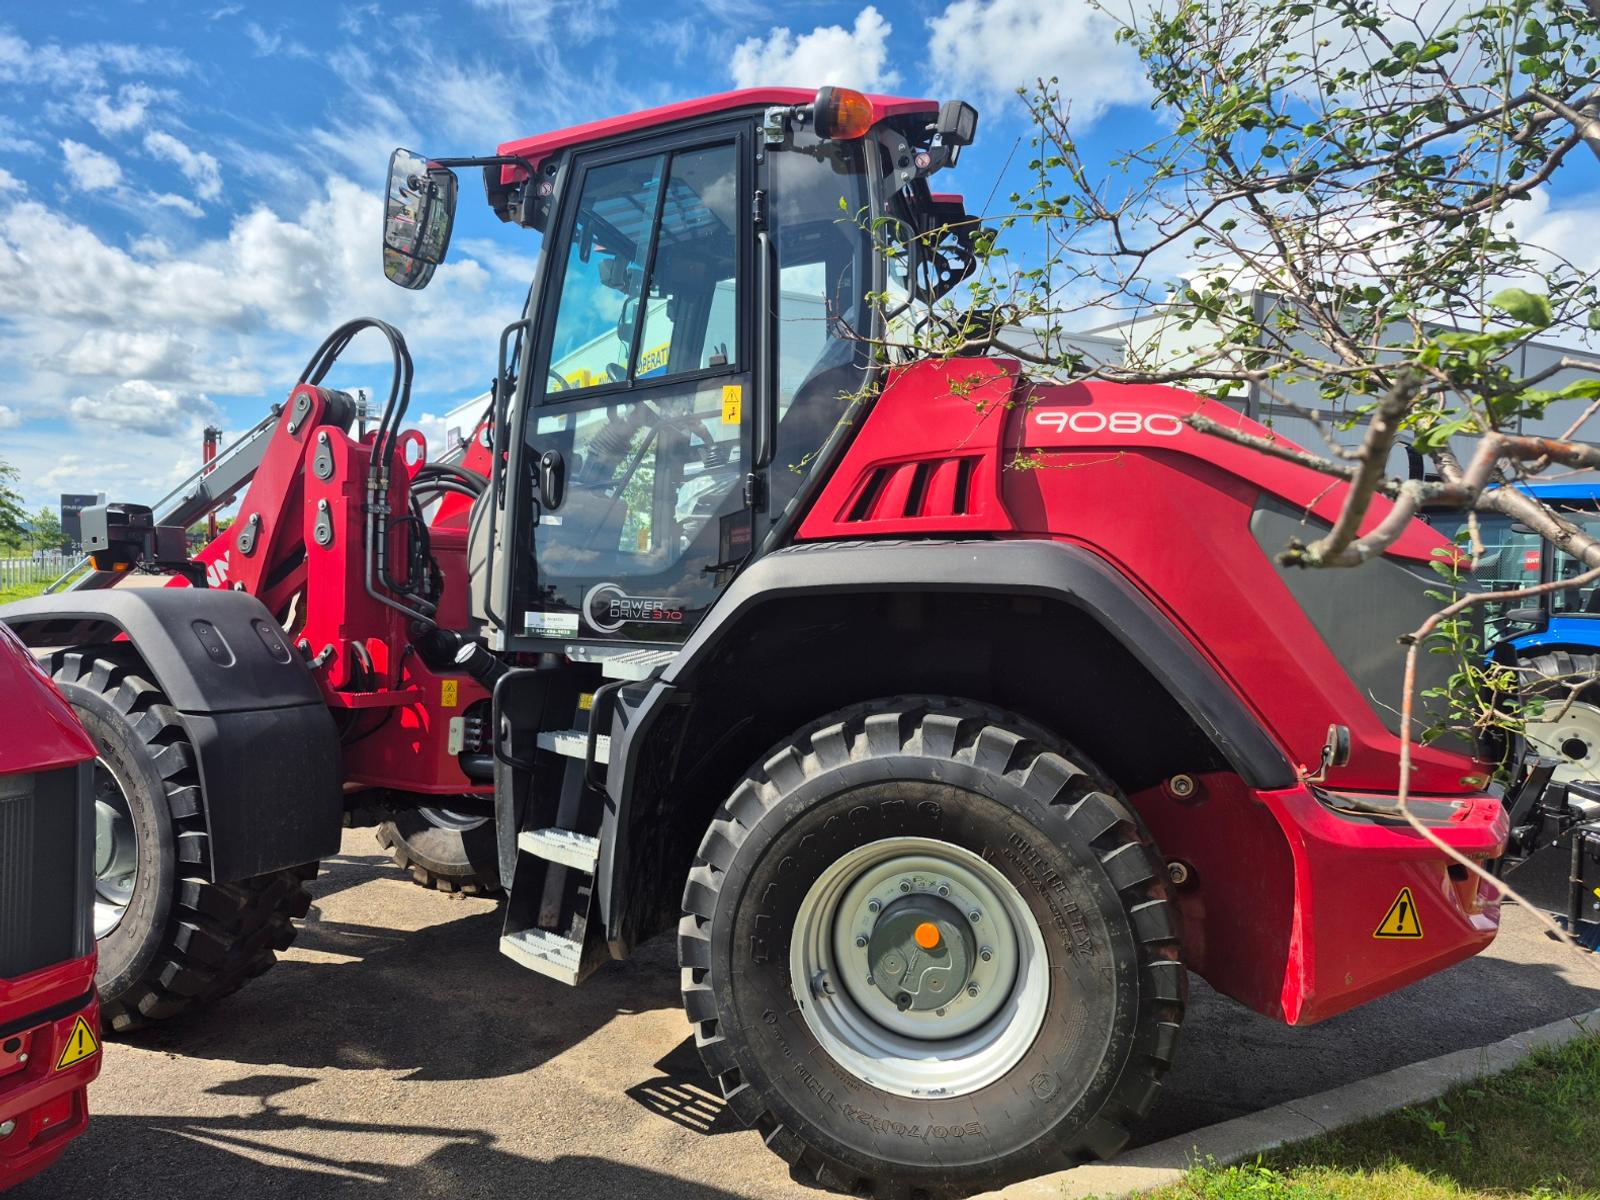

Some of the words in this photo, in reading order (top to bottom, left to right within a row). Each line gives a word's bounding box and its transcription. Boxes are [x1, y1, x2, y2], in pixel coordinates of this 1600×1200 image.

[1035, 411, 1183, 436] 9080
[610, 599, 663, 609] POWER
[610, 609, 651, 619] DRIVE
[652, 610, 682, 620] 370
